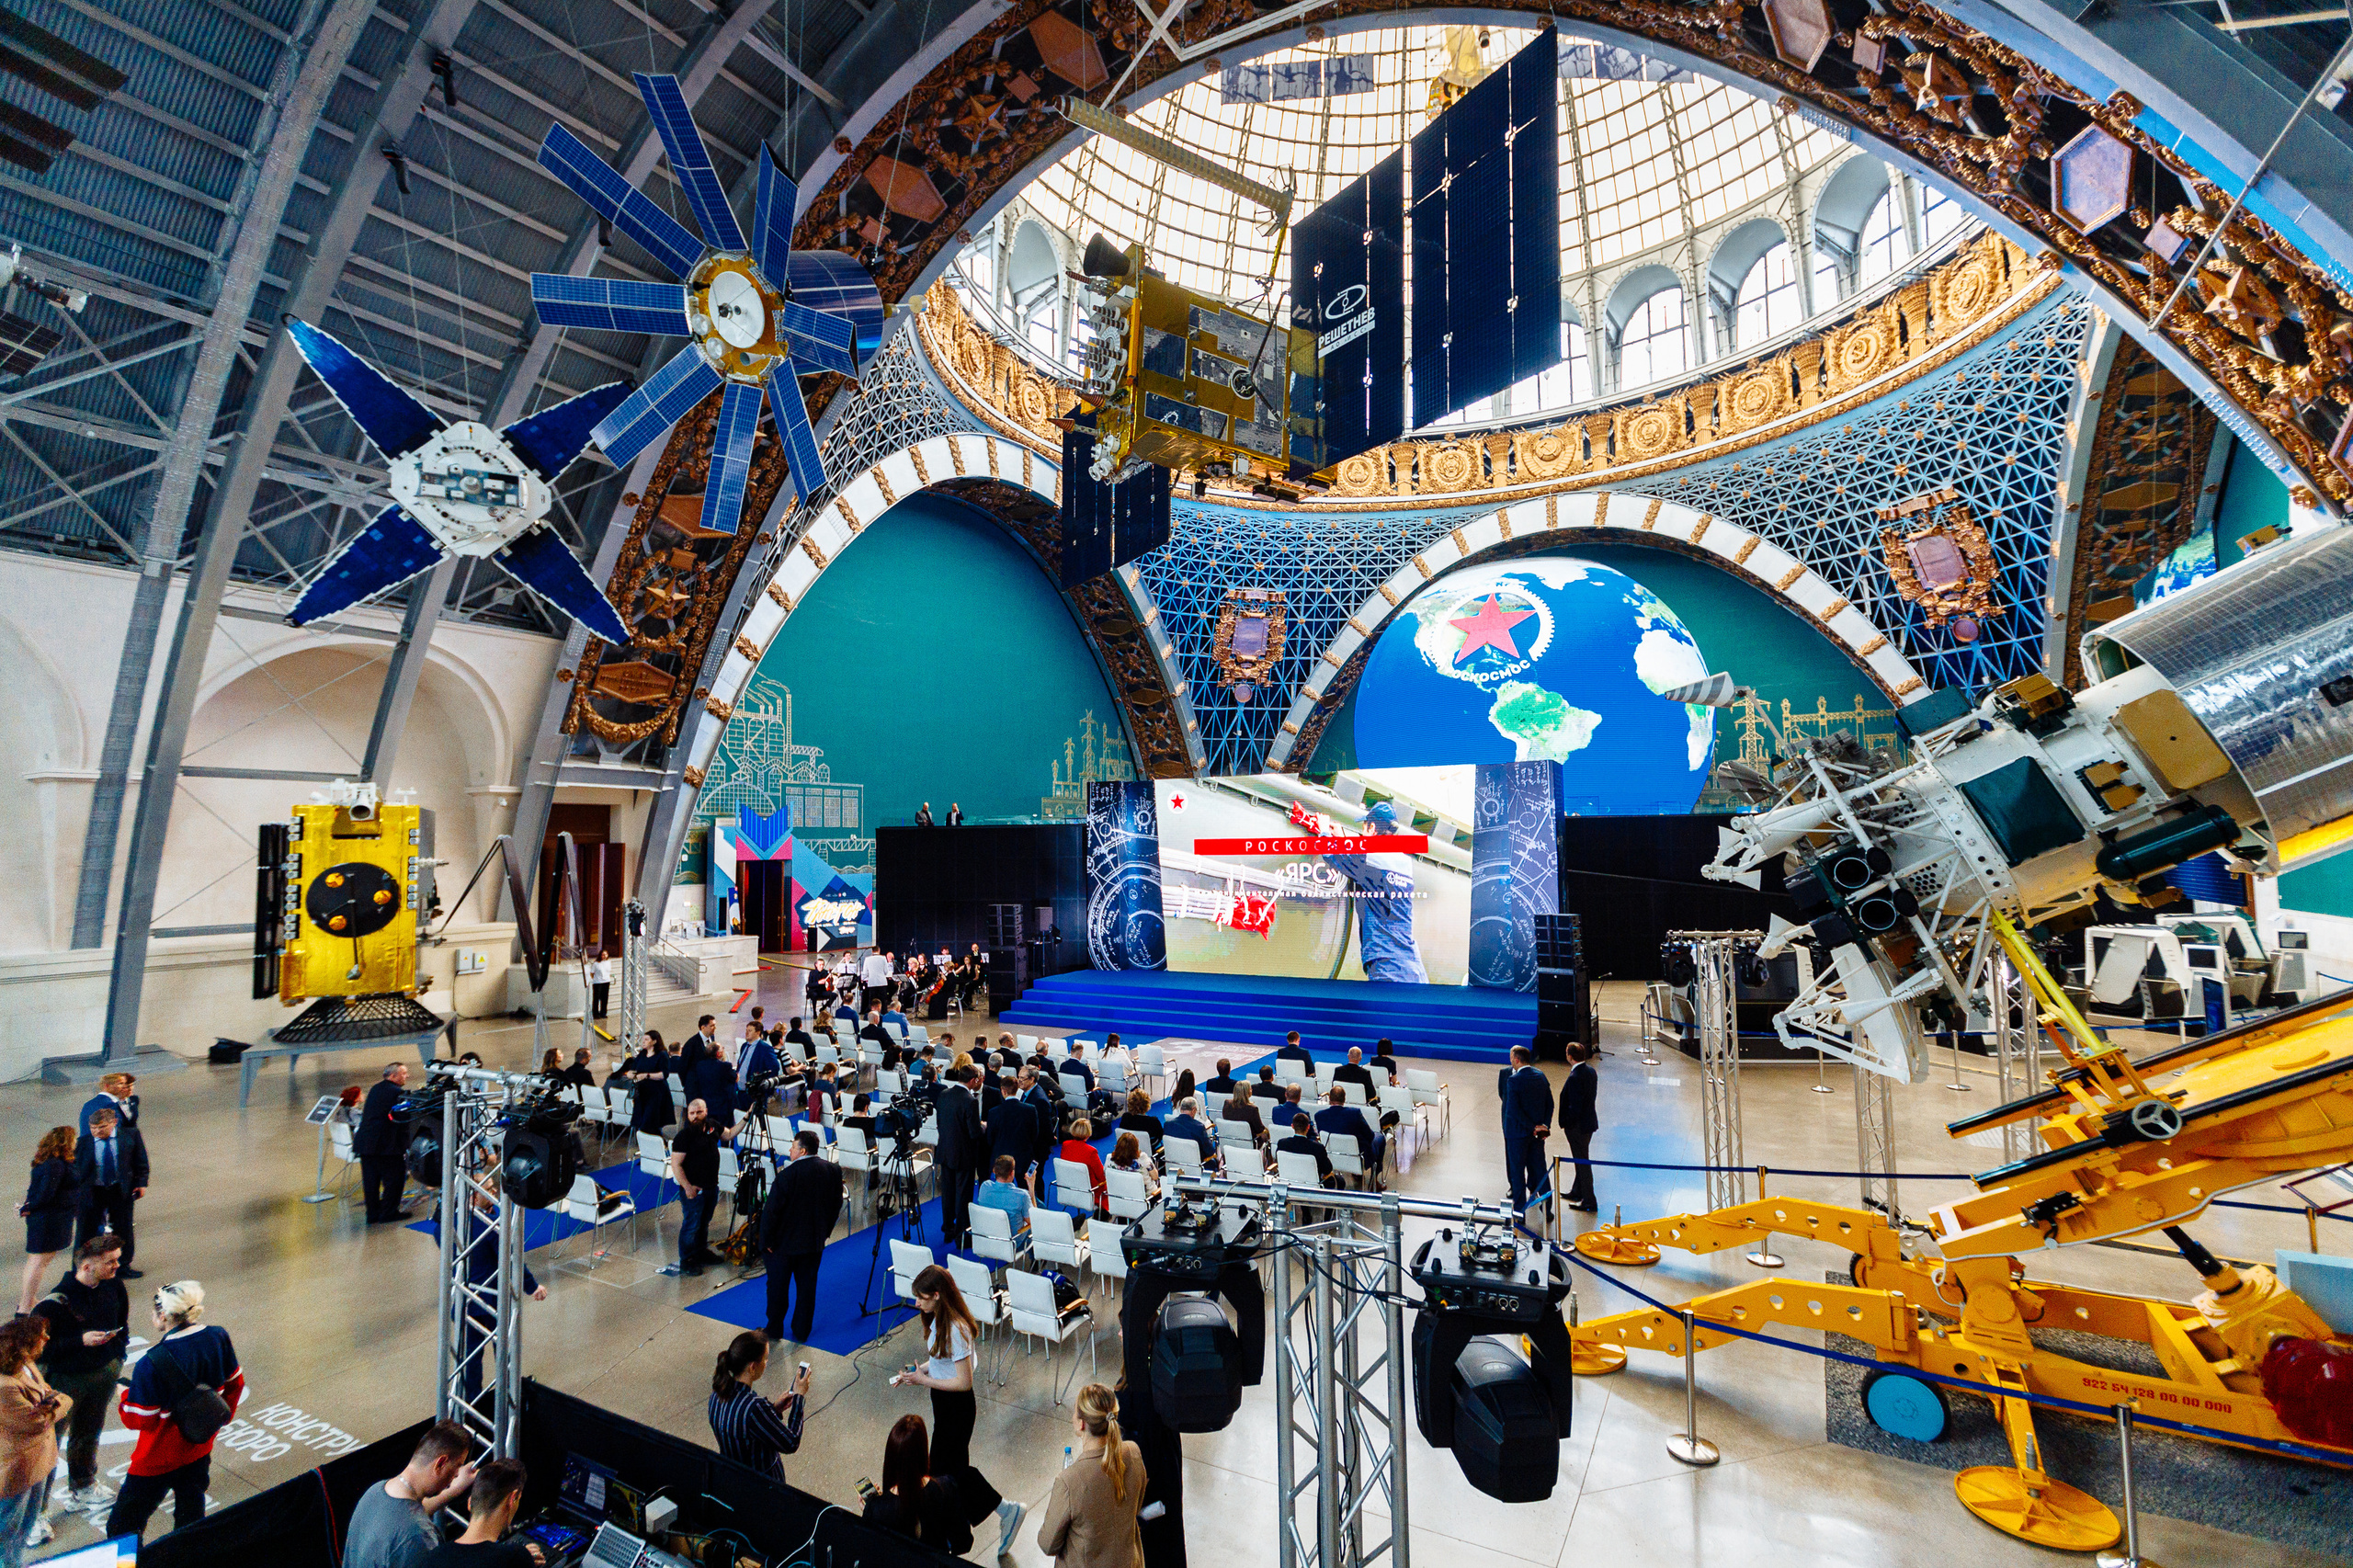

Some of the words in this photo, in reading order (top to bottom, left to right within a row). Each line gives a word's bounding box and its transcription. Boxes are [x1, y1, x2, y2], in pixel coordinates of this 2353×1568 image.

[1447, 660, 1530, 682] ОСКОСМОС
[1245, 838, 1368, 852] РОСКОСМОС
[1275, 862, 1339, 884] «ЯРС»
[1390, 891, 1428, 901] ракета
[2082, 1378, 2108, 1390] 922
[2111, 1382, 2130, 1394] 54
[2132, 1387, 2155, 1400] 128
